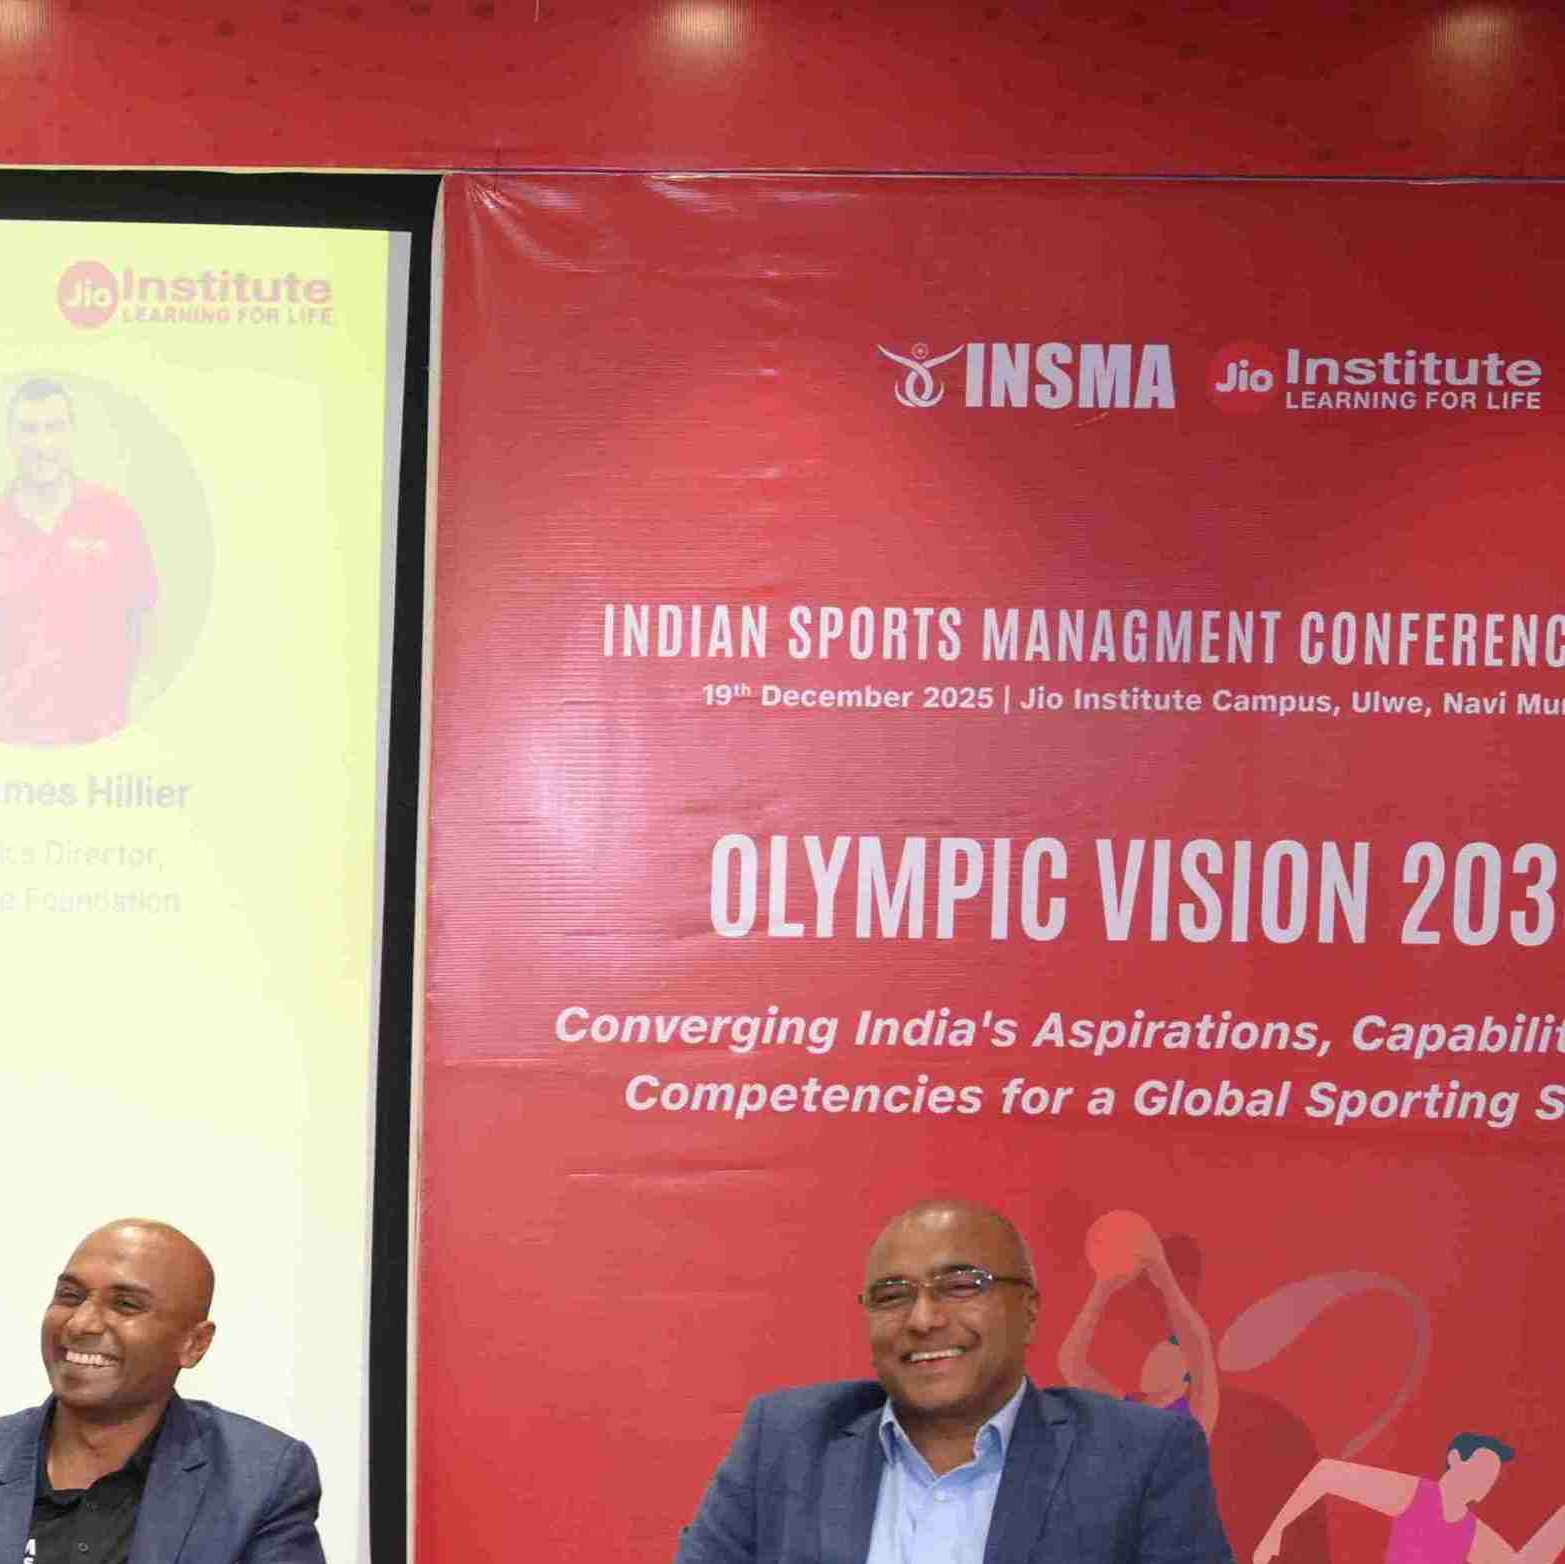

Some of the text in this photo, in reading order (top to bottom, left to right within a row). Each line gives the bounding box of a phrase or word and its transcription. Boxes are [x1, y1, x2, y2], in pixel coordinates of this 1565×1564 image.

[65, 265, 334, 308] Jio Institute
[122, 304, 335, 328] LEARNING FOR LIFE
[965, 342, 1177, 410] INSMA
[1215, 347, 1543, 394] Jio Institute
[1285, 391, 1542, 411] LEARNING FOR LIFE
[602, 603, 768, 658] INDIAN
[788, 605, 962, 662] SPORTS
[982, 608, 1282, 665] MANAGMENT
[703, 682, 751, 706] 19th
[761, 685, 914, 709] December
[923, 686, 995, 710] 2025
[1020, 687, 1065, 711] Jio
[1073, 687, 1203, 712] Institute
[1212, 689, 1342, 718] Campus,
[1351, 691, 1432, 719] Ulwe,
[1442, 691, 1507, 715] Navi
[86, 773, 195, 810] Hillier
[709, 833, 1069, 942] OLYMPIC
[1094, 838, 1370, 945] VISION
[554, 1004, 839, 1055] Converging
[853, 1007, 1019, 1048] India's
[1031, 1008, 1332, 1057] Aspirations,
[624, 1073, 1565, 1128] Competencies for a Global Sporting S
